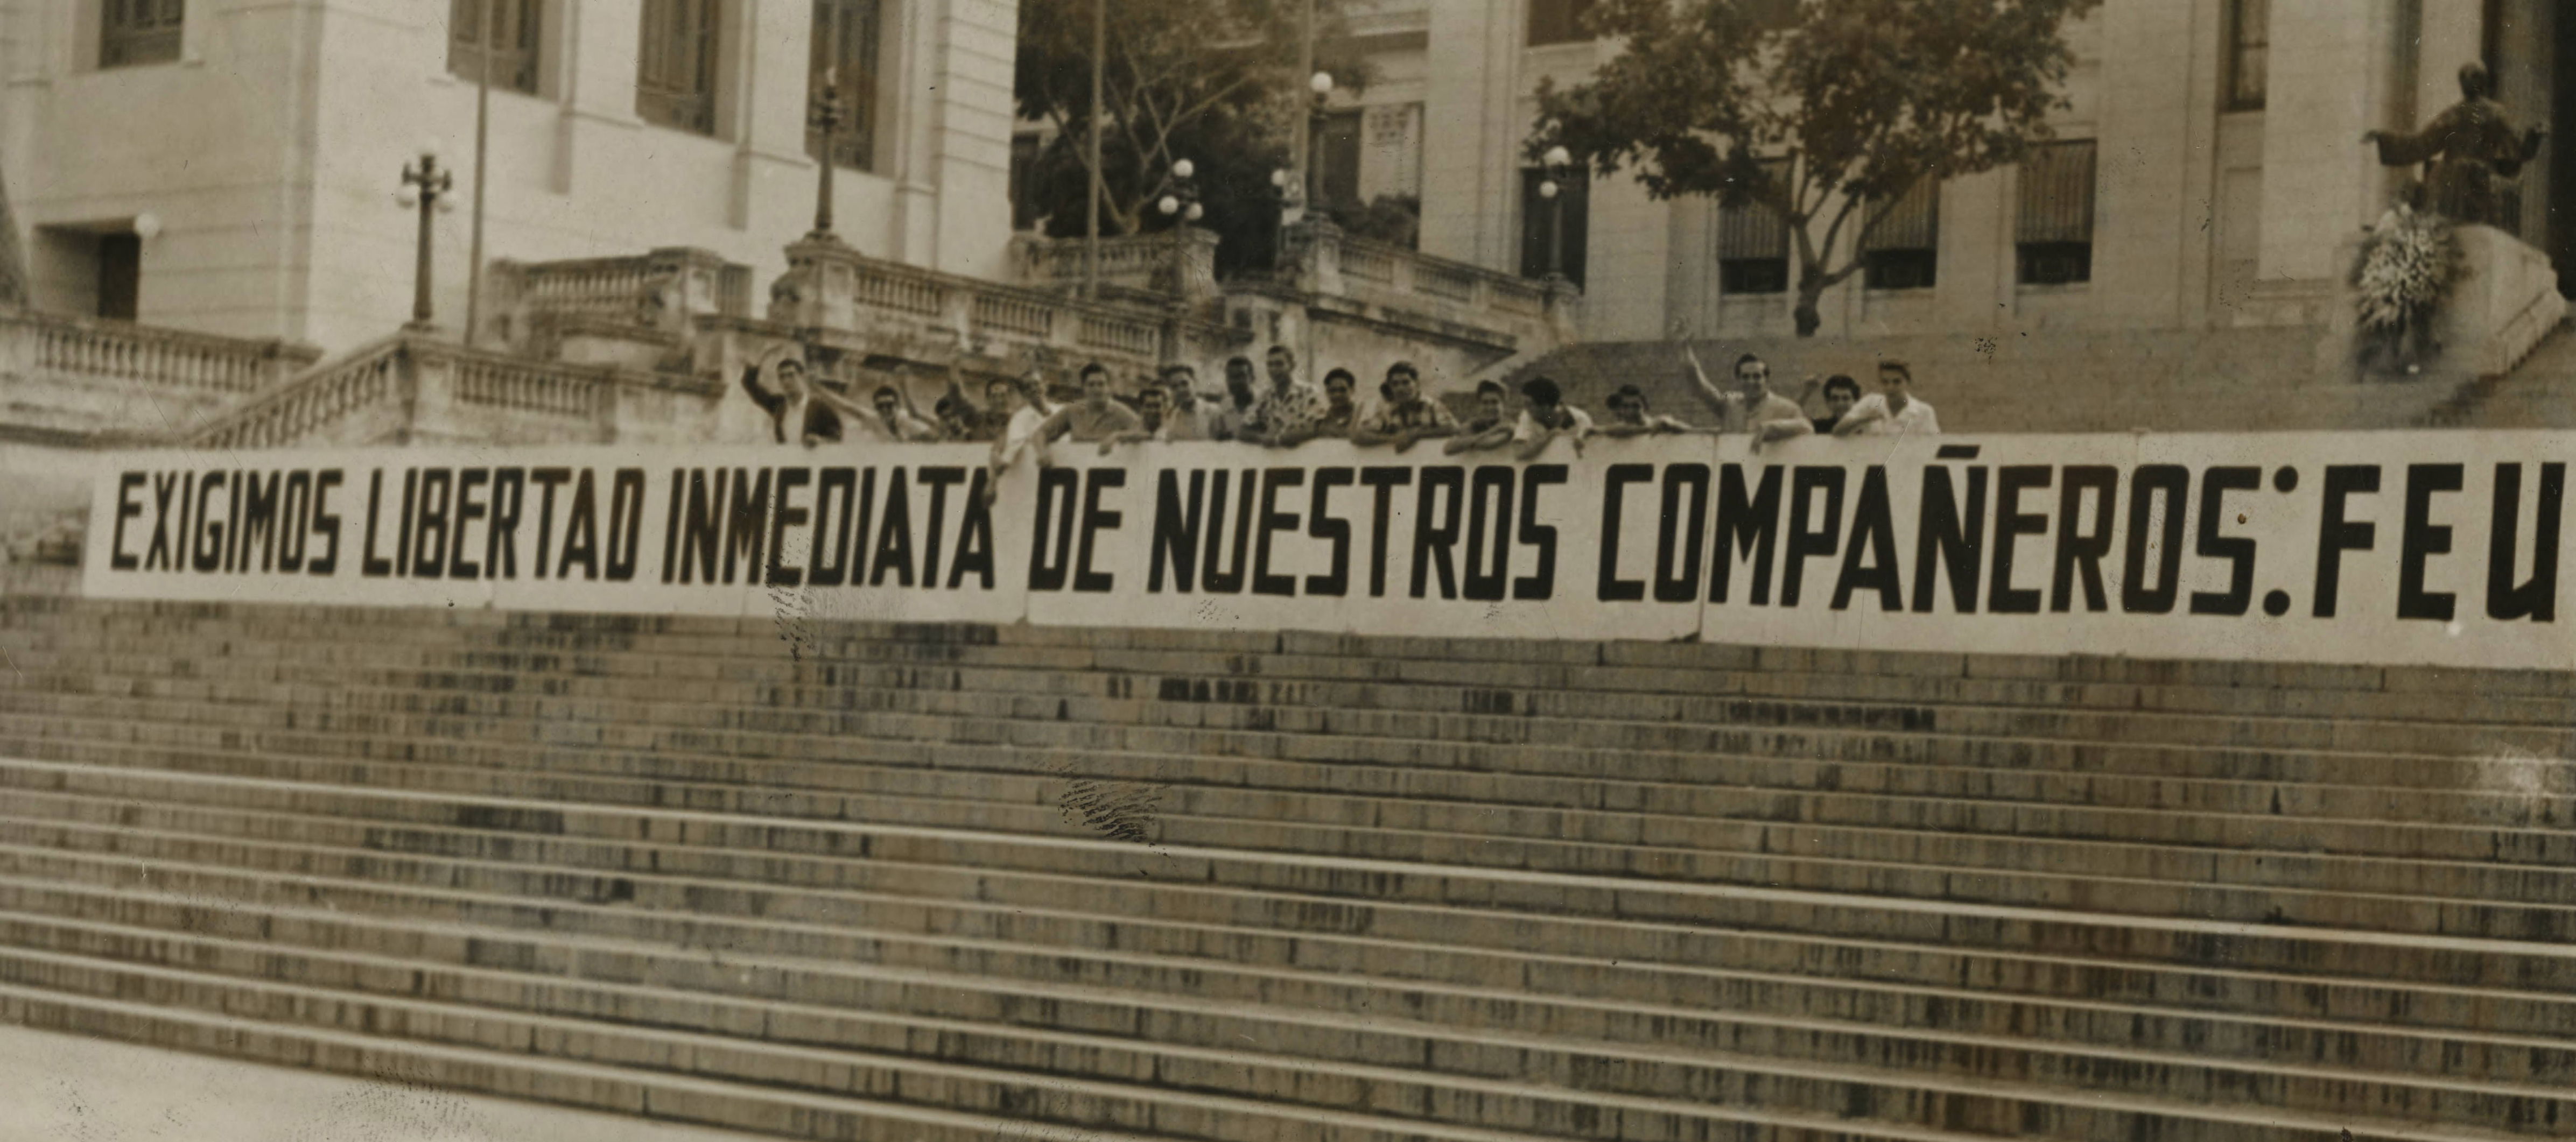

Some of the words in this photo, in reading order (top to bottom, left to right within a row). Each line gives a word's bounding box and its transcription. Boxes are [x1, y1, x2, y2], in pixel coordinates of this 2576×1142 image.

[110, 469, 344, 576] EXIGIMOS
[362, 467, 646, 582] LIBERTAD
[661, 465, 995, 589] INMEDIATA
[1027, 466, 1127, 593] DE
[1147, 464, 1570, 601] NUESTROS
[2312, 461, 2566, 623] FEU
